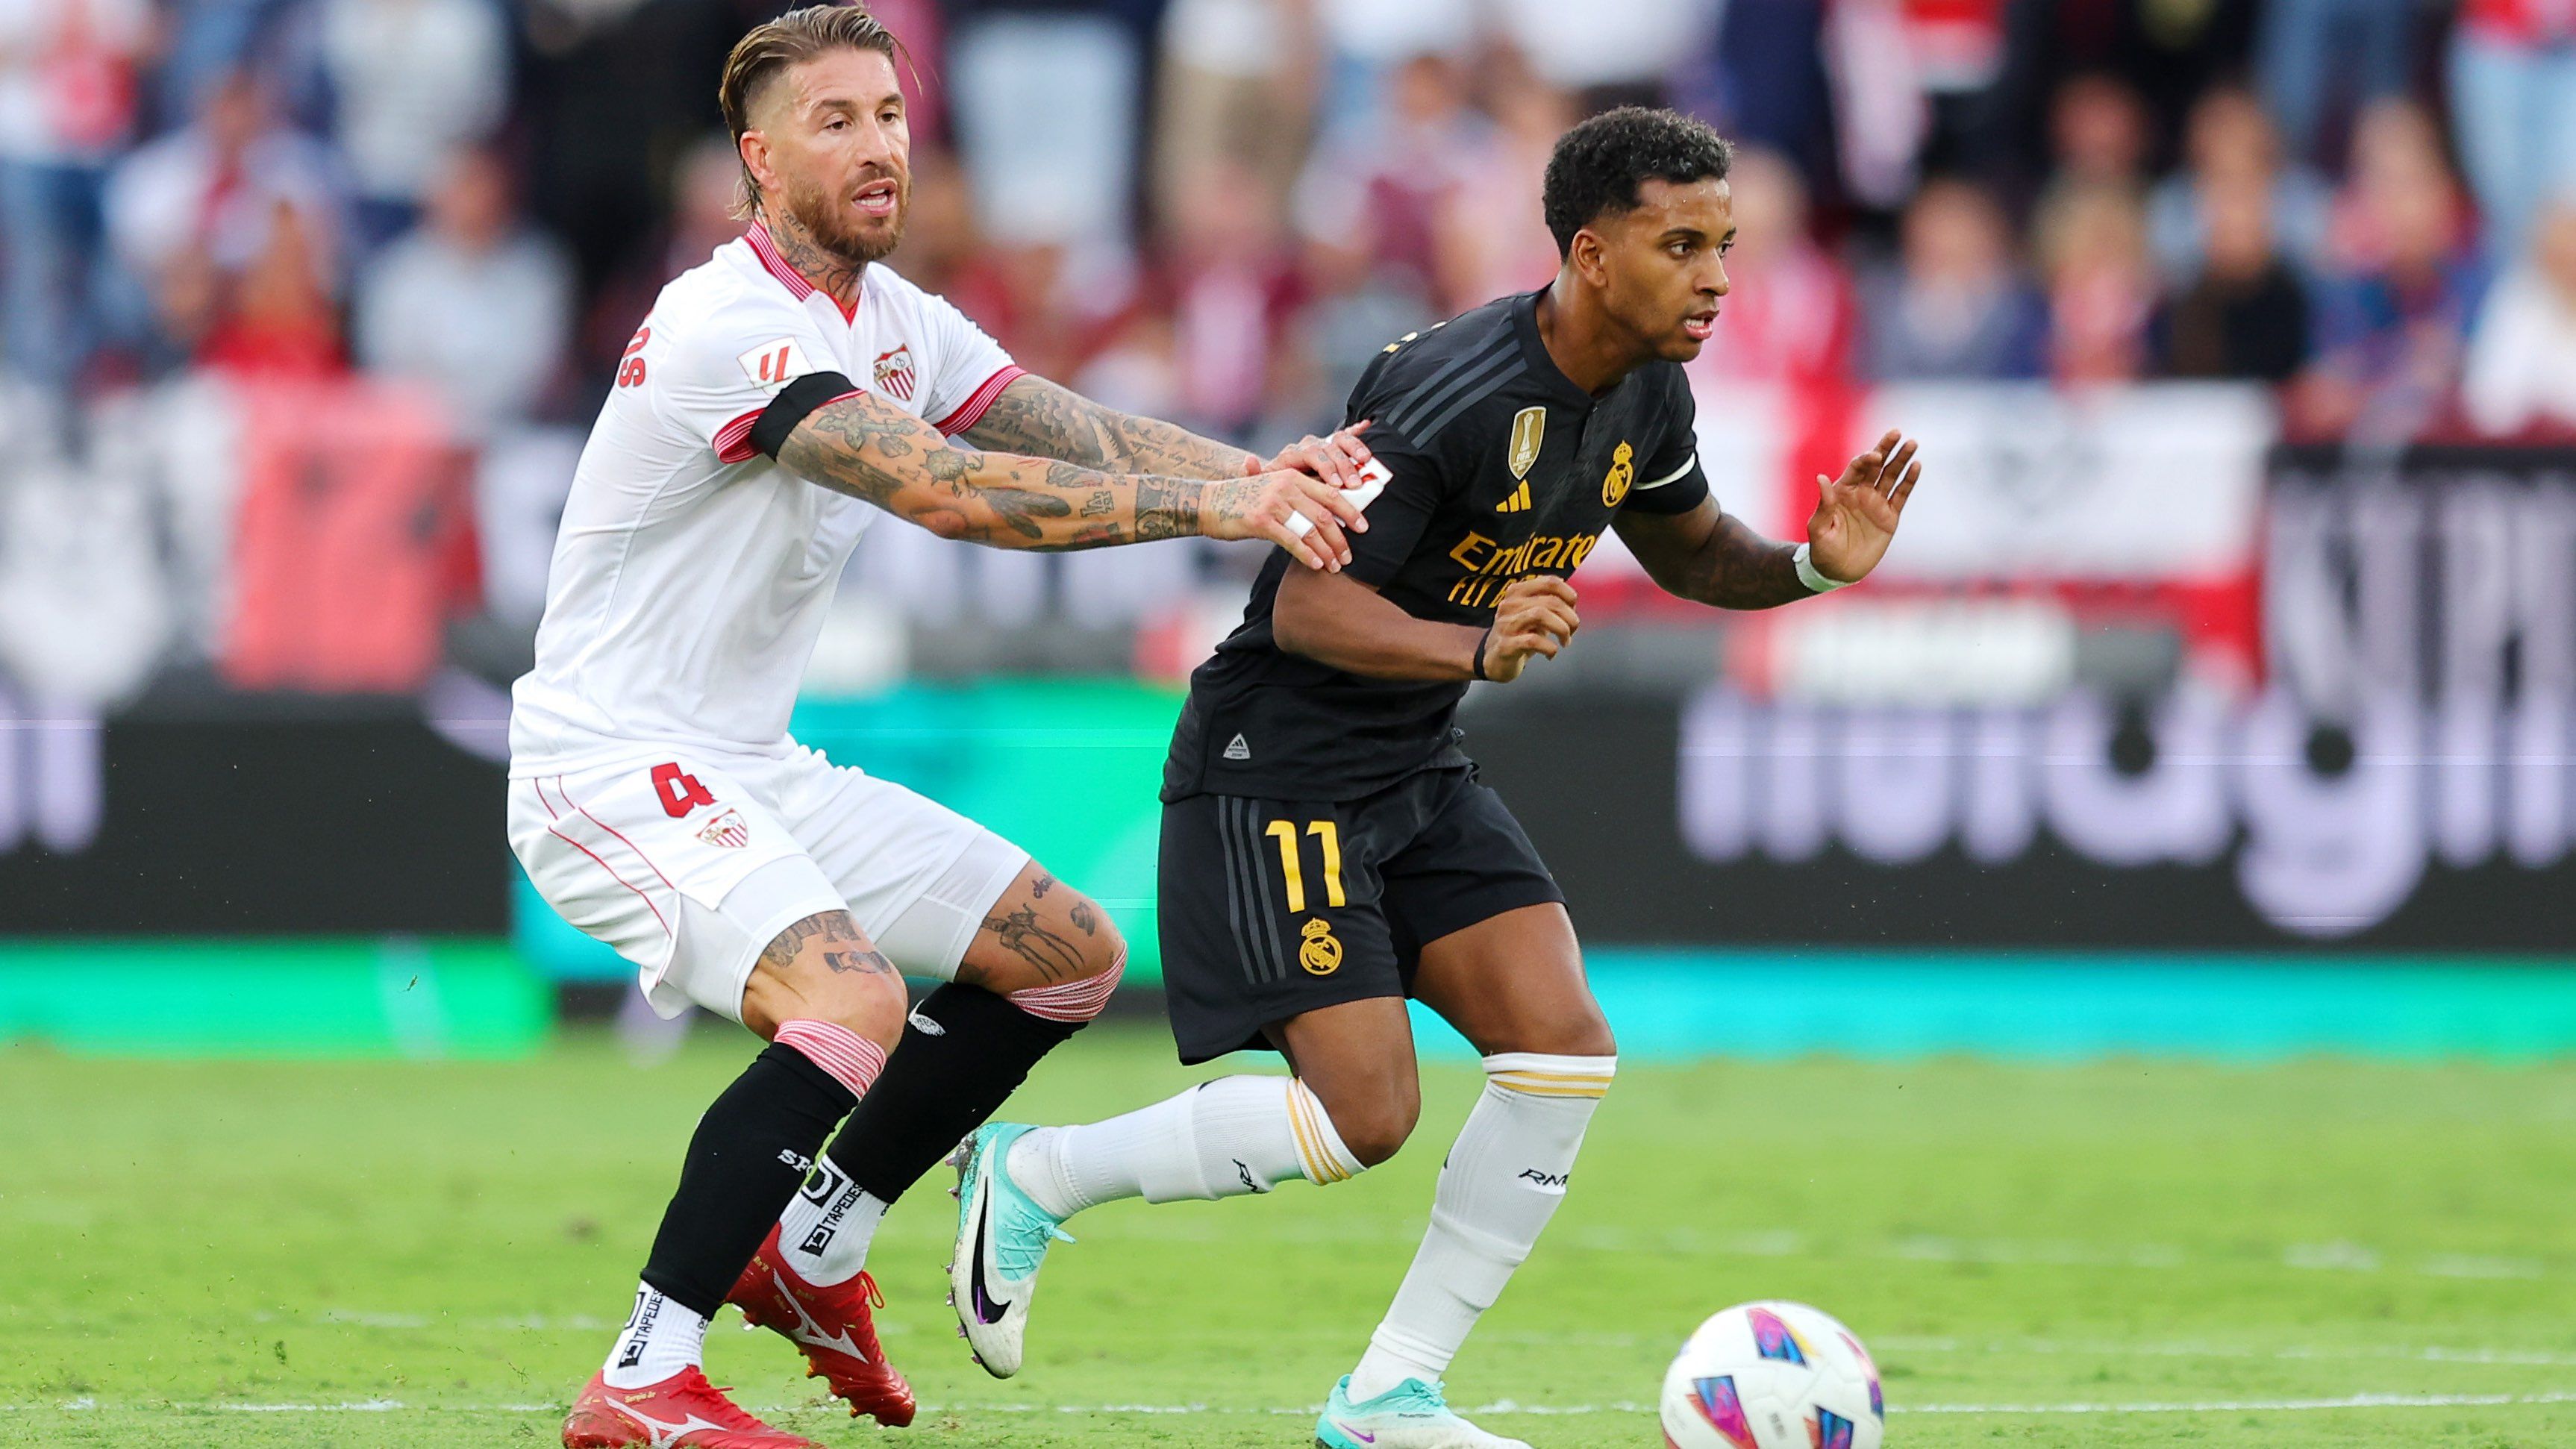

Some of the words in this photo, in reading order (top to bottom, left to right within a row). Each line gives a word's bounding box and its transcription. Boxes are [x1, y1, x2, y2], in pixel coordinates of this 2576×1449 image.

[1447, 575, 1500, 608] FLY
[651, 762, 719, 818] 4
[1266, 819, 1345, 914] 11
